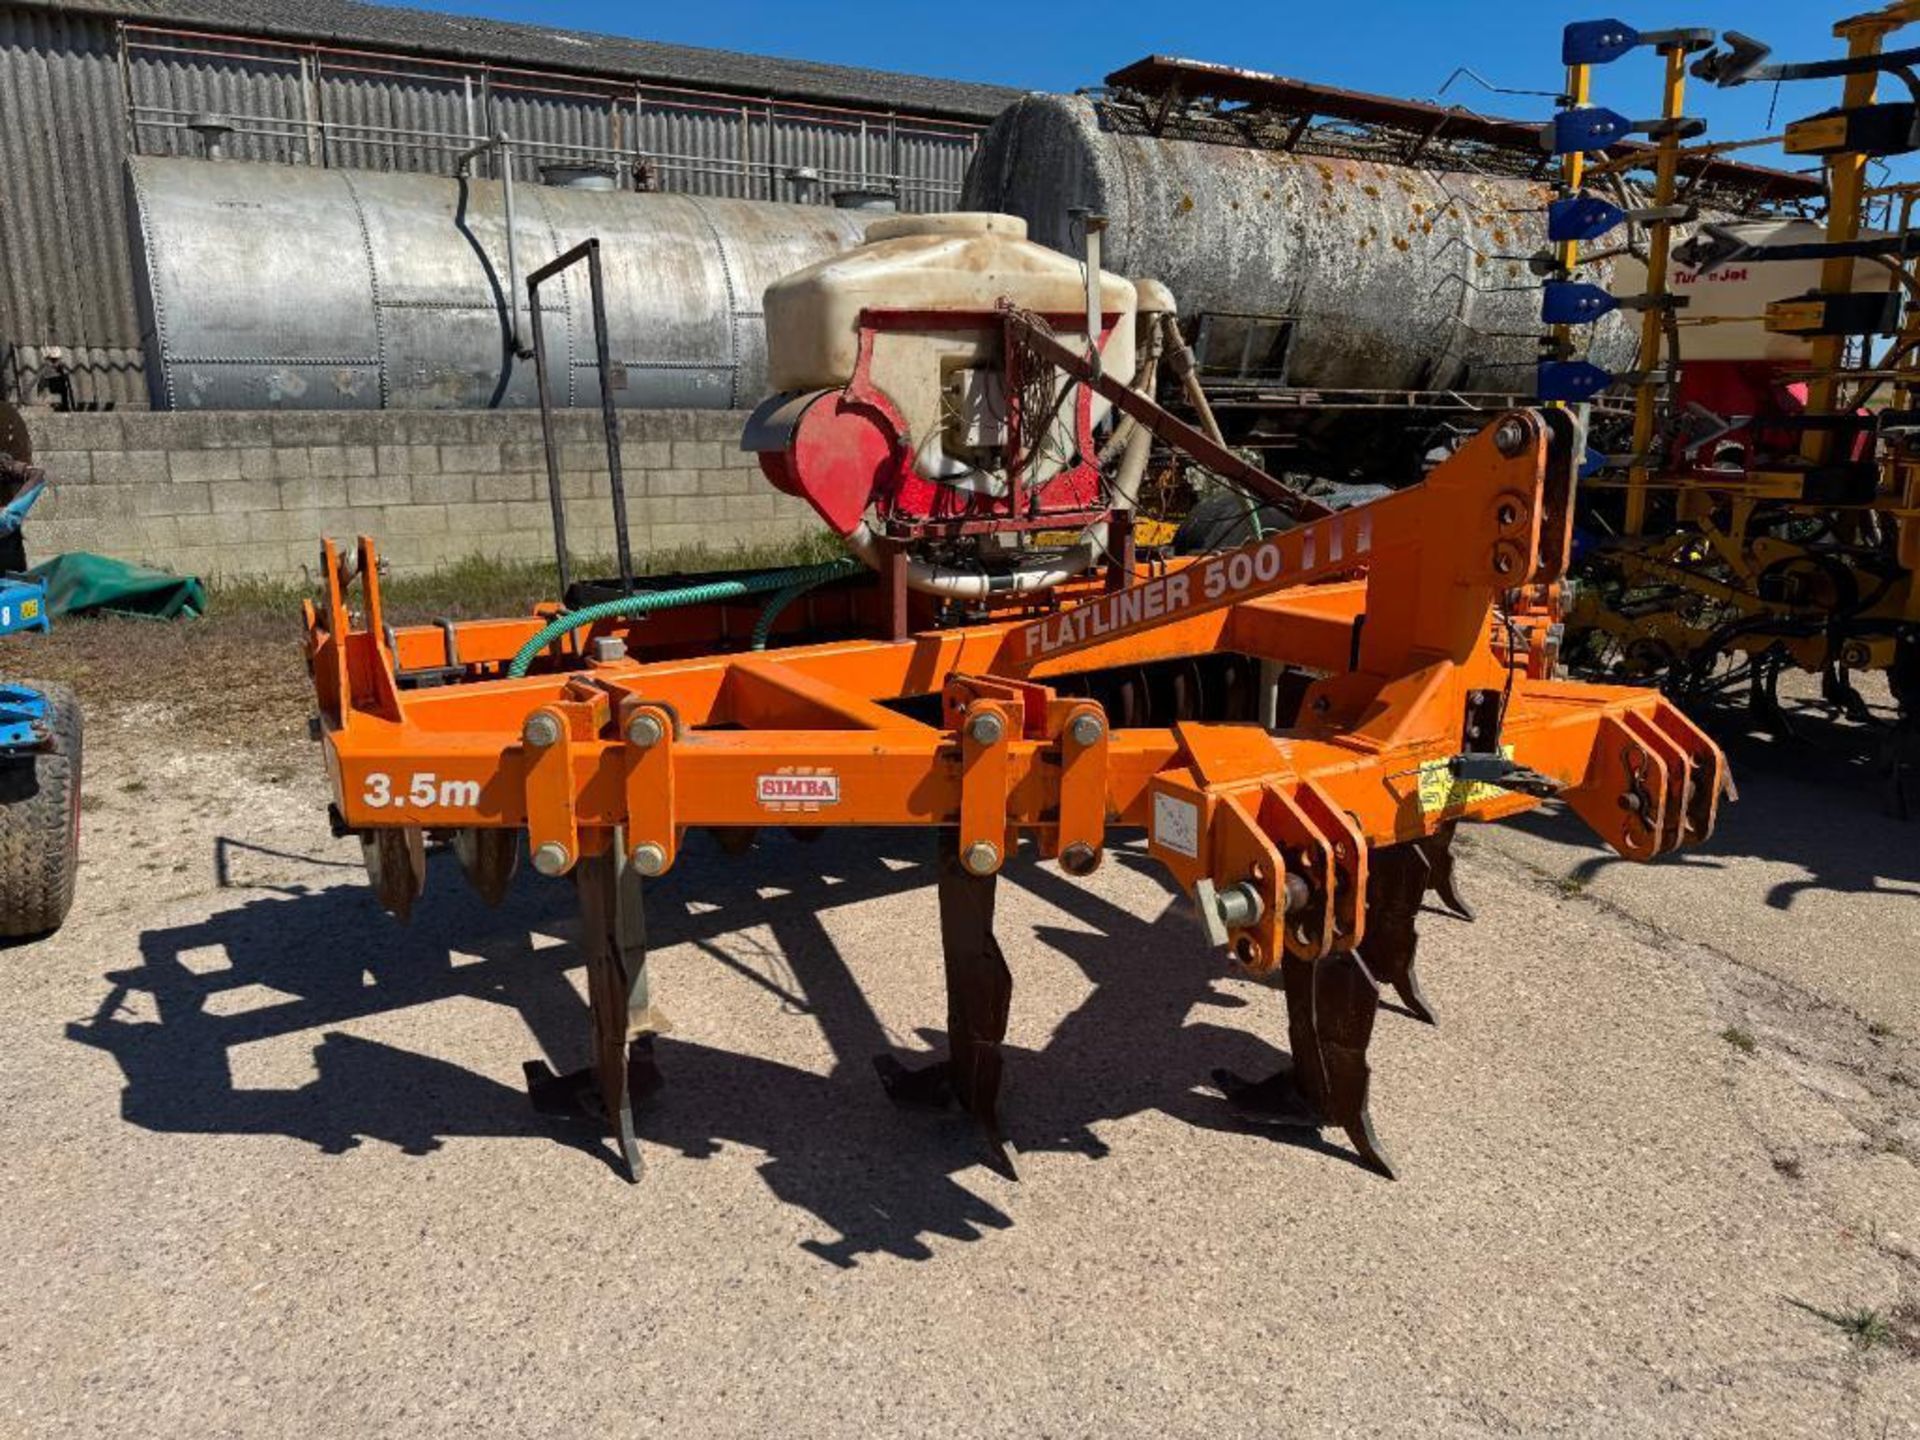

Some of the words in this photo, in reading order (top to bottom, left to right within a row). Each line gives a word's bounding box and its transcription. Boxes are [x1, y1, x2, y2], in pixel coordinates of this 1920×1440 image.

[1025, 576, 1190, 657] FLATLINER
[1204, 544, 1281, 599] 500
[363, 772, 480, 808] 3.5m
[762, 780, 834, 796] SIMBA
